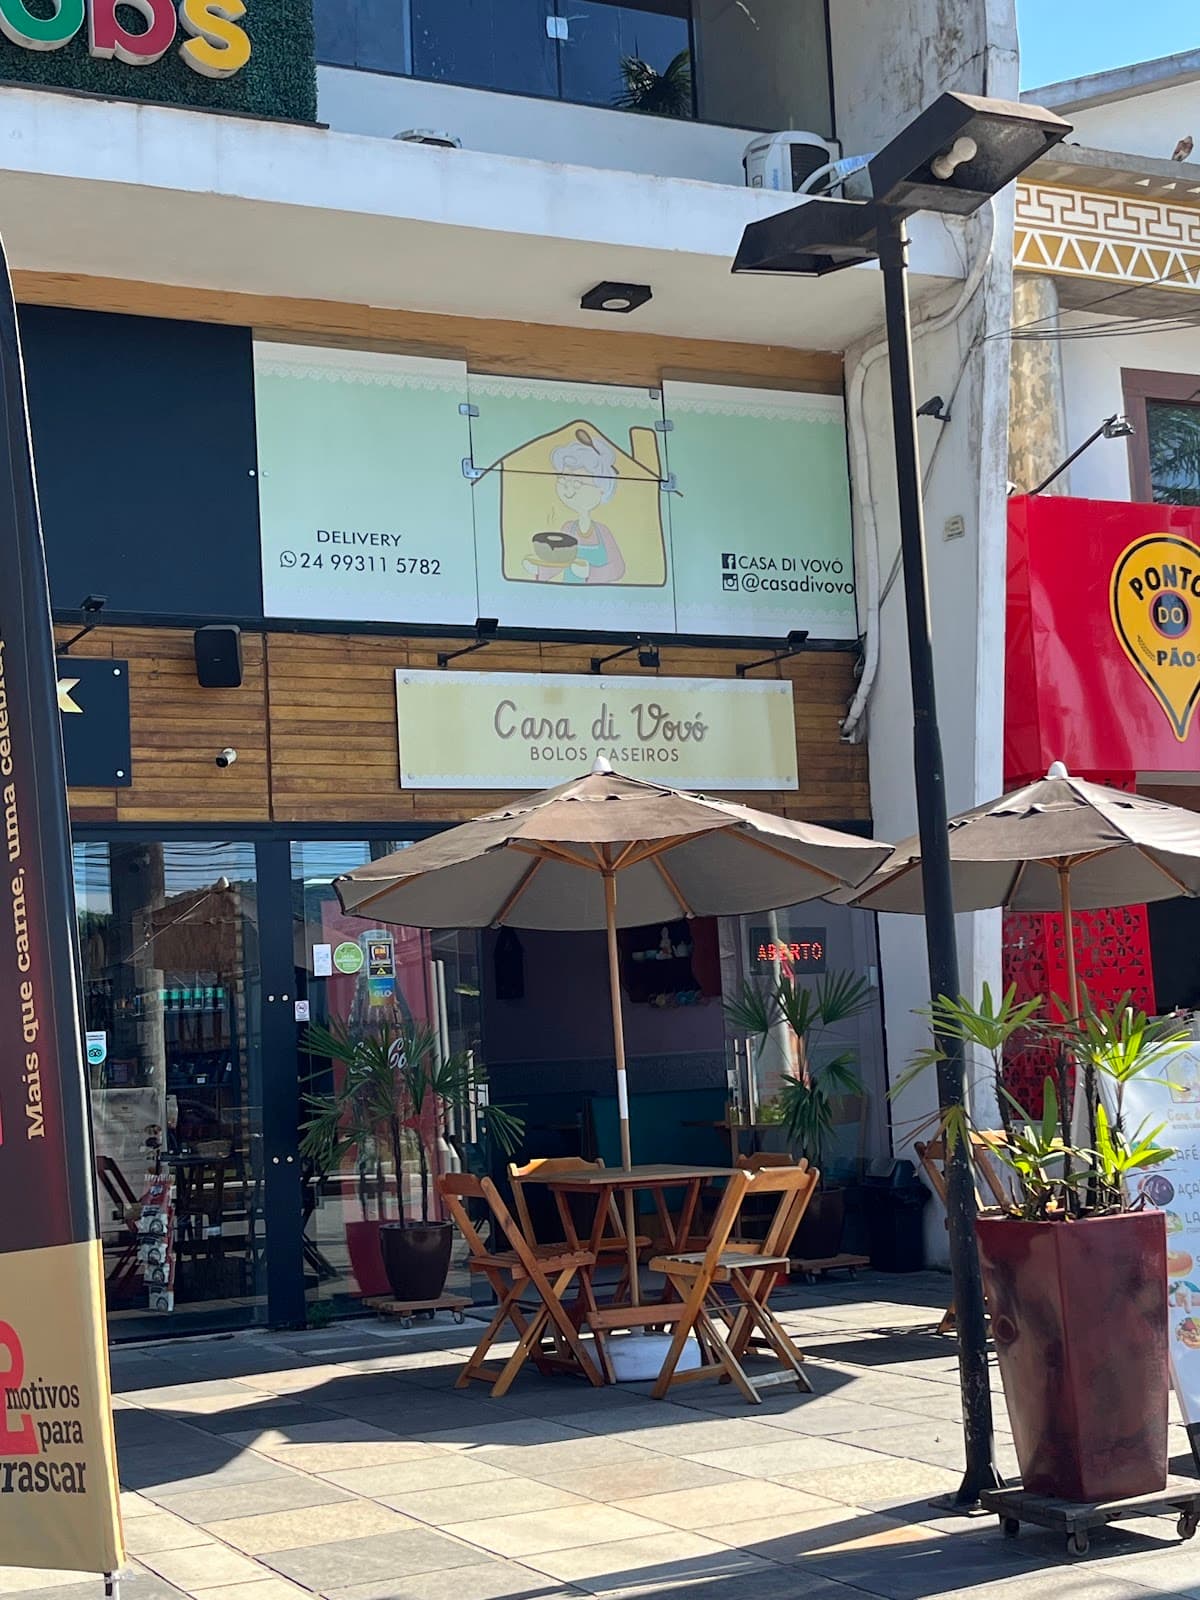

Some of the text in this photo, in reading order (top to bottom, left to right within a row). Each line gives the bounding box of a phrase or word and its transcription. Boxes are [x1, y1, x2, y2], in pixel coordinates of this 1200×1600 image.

[317, 530, 402, 547] DELIVERY
[300, 552, 441, 575] 24 99311 5782
[738, 555, 777, 571] CASA
[782, 558, 796, 572] DI
[742, 572, 855, 594] @casadivovo
[1129, 564, 1200, 600] PONTO
[1157, 606, 1184, 624] DO
[1157, 647, 1195, 667] PÃO
[494, 699, 709, 743] Casa di Vovó
[530, 746, 588, 761] BOLOS
[4, 783, 21, 862] uma
[11, 868, 31, 972] carne,
[757, 942, 822, 960] ABERTO
[20, 981, 40, 1043] que
[22, 1051, 45, 1139] Mais
[1178, 1183, 1200, 1200] AÇA
[5, 1377, 80, 1410] motivos
[37, 1419, 84, 1451] para
[0, 1461, 87, 1493] rascar
